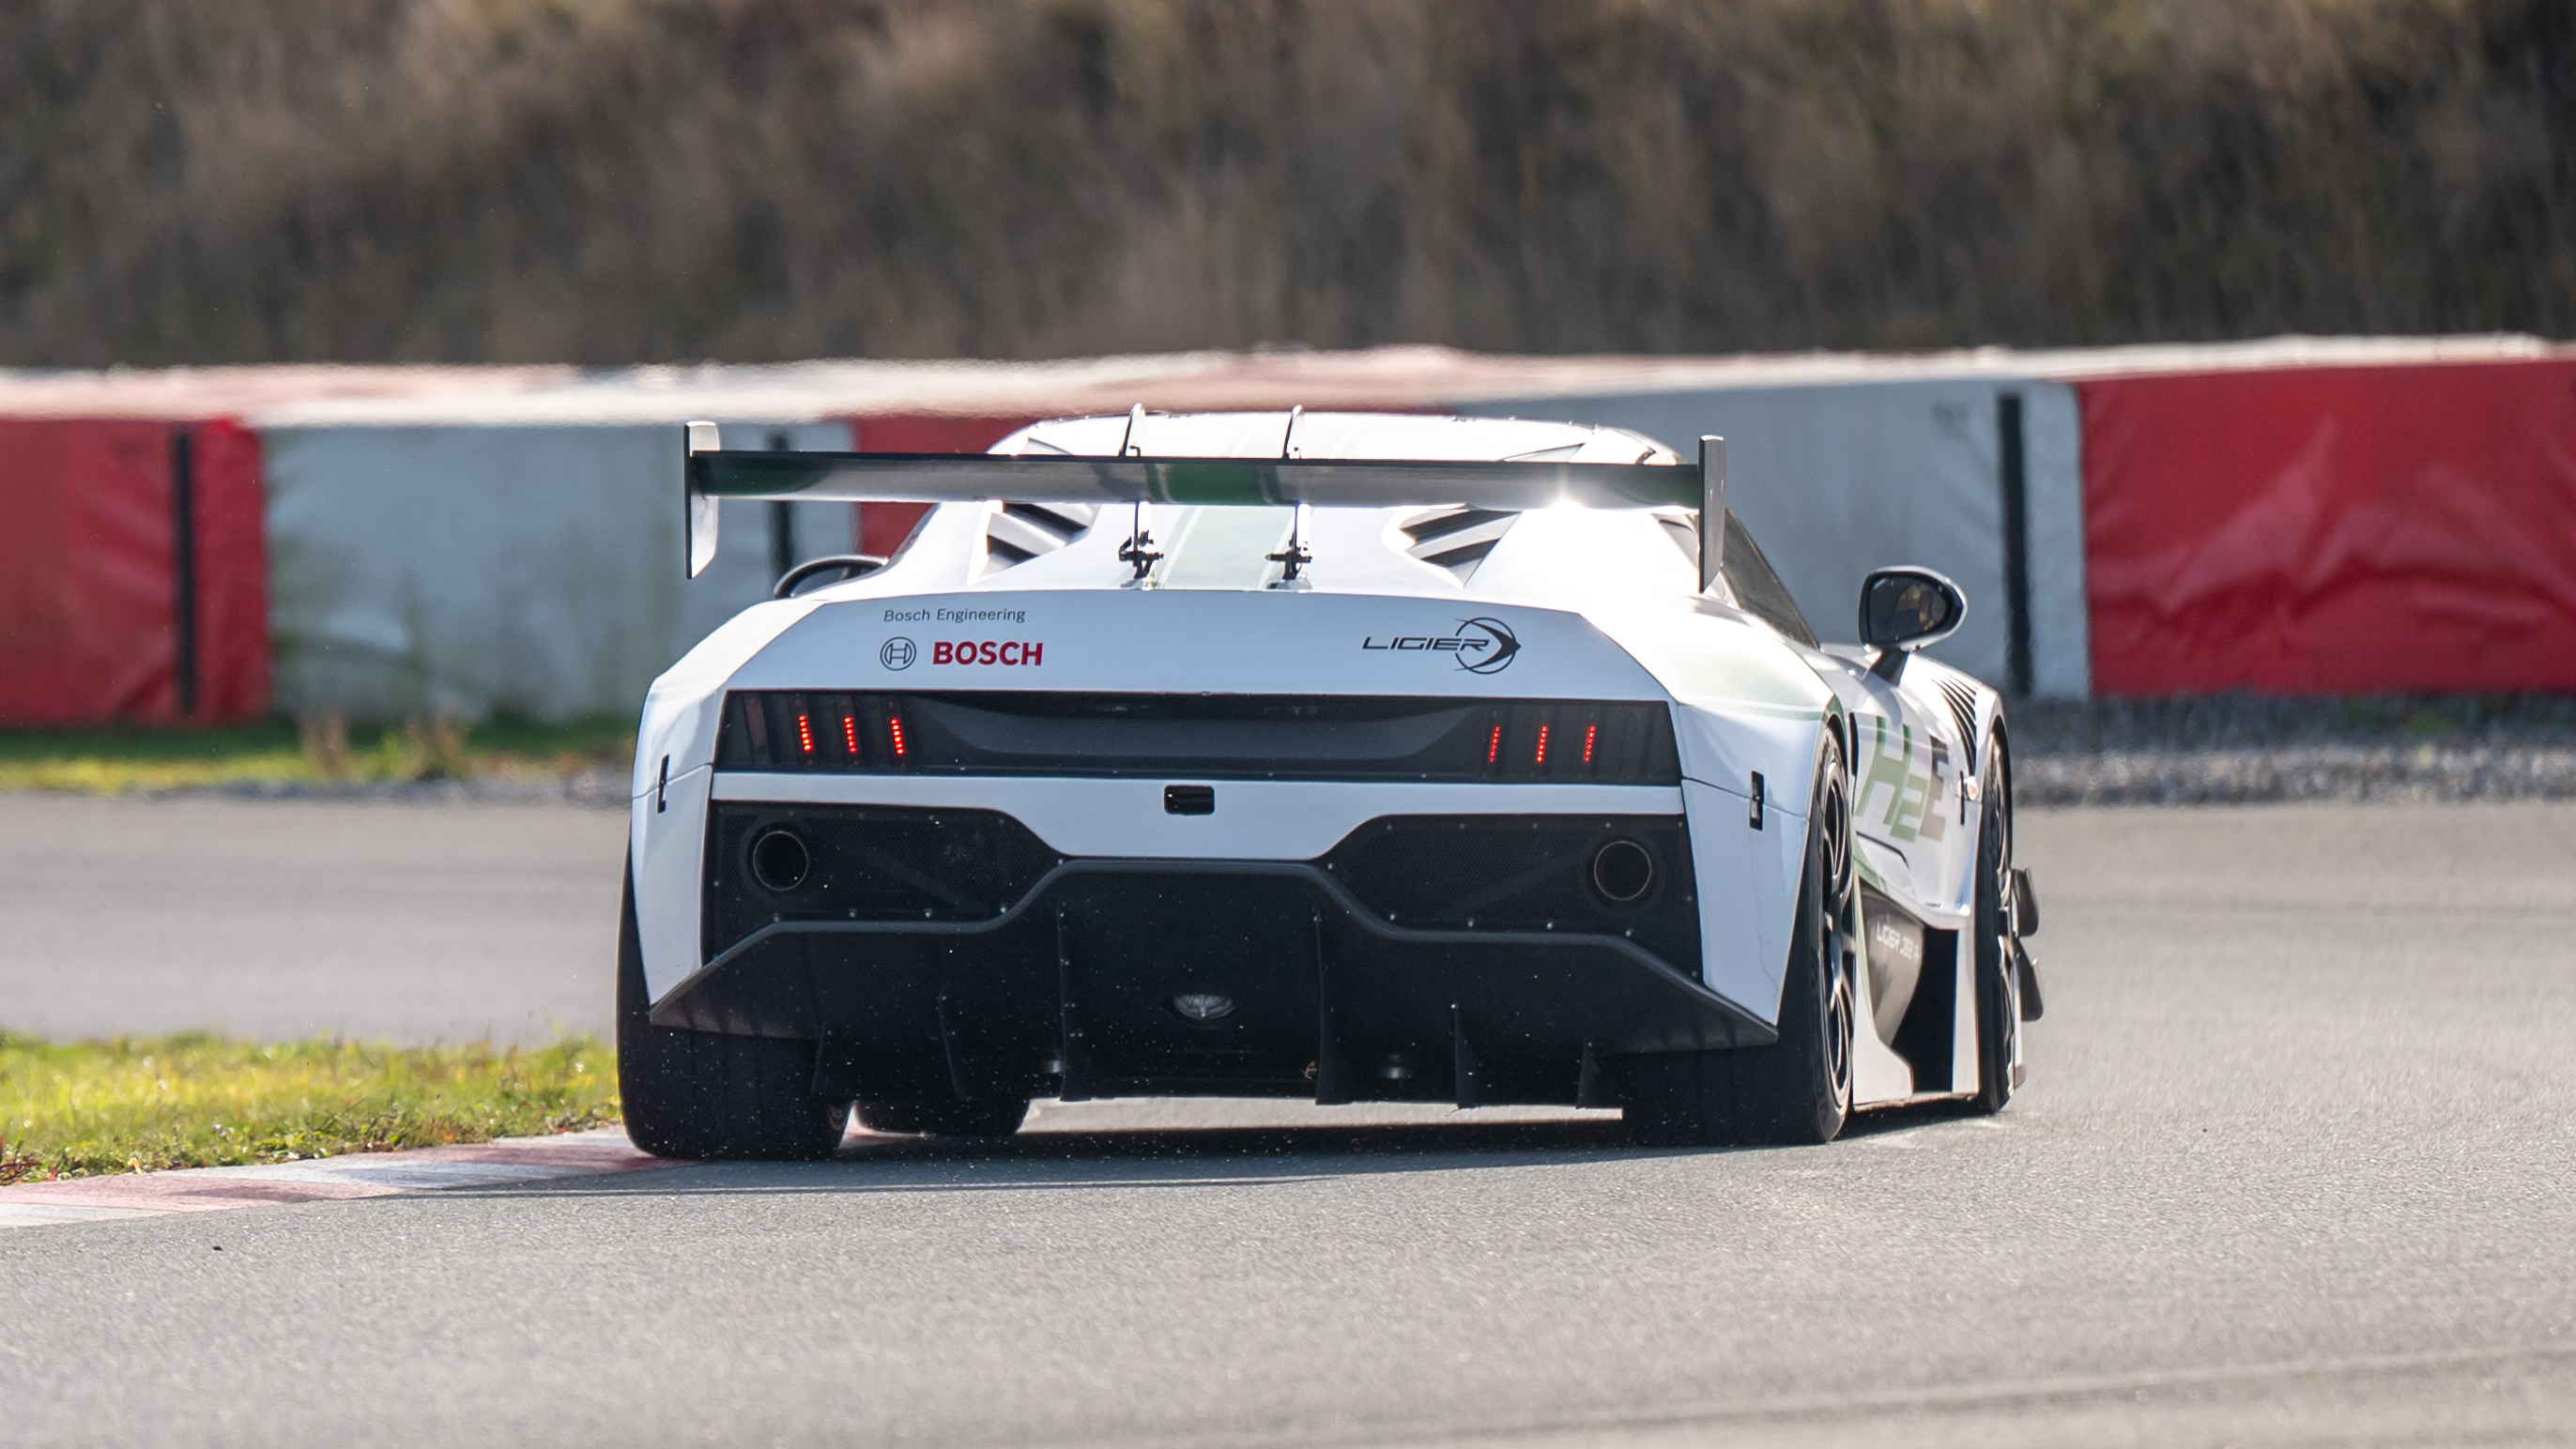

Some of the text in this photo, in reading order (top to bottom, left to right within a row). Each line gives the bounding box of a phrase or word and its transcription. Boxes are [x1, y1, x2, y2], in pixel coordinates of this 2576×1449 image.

[883, 607, 1026, 624] Bosch Engineering
[1362, 636, 1491, 652] LIGIER
[932, 641, 1044, 666] BOSCH
